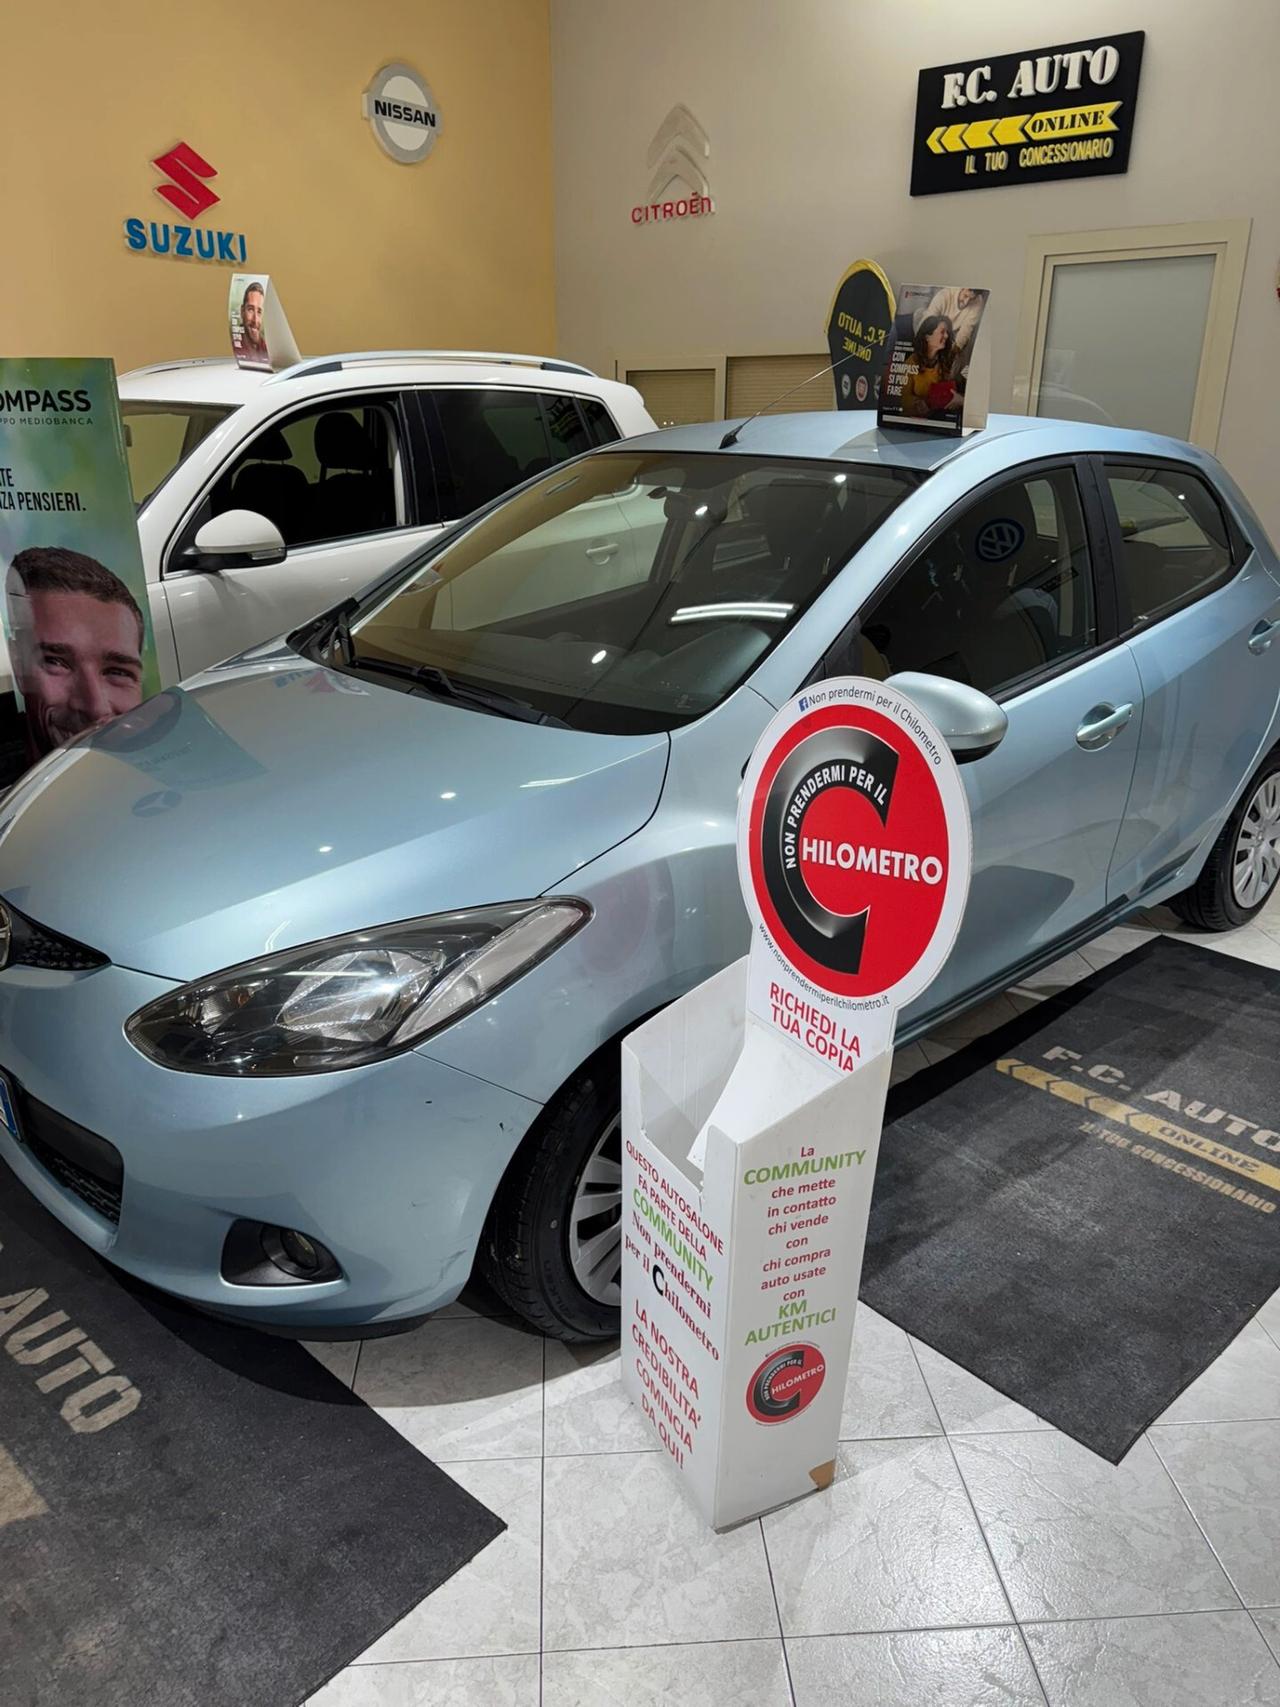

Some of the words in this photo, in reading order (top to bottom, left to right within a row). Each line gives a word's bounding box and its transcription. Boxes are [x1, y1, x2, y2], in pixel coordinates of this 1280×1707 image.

[941, 65, 997, 109] F.C.
[1007, 45, 1120, 98] AUTO
[374, 99, 436, 127] NISSAN
[1031, 110, 1105, 134] ONLINE
[964, 154, 977, 174] IL
[985, 151, 1008, 171] TUO
[1019, 137, 1114, 167] CONCESSIONARIO
[125, 217, 248, 263] SUZUKI
[890, 362, 920, 375] COMPASS
[0, 390, 91, 412] MPASS
[20, 417, 93, 425] MEDIOBANCA
[0, 468, 14, 487] TE
[0, 491, 15, 510] ZA
[17, 491, 87, 512] PENSIERI.
[808, 690, 826, 706] Non
[828, 686, 876, 701] prendermi
[876, 695, 893, 709] per
[893, 703, 901, 714] il
[900, 708, 942, 766] Chilometro
[787, 764, 845, 828] PRENDERMI
[849, 766, 873, 792] PER
[874, 783, 888, 806] IL
[784, 832, 797, 869] NON
[769, 982, 837, 1041] RICHIEDI
[841, 1027, 861, 1057] LA
[771, 1003, 801, 1040] TUA
[805, 1028, 855, 1072] COPIA
[1143, 1089, 1280, 1153] AUTO
[744, 1150, 867, 1185] COMMUNITY
[800, 1146, 815, 1158] La
[1158, 1126, 1261, 1174] ONLINE
[771, 1186, 794, 1199] che
[798, 1178, 836, 1194] mette
[1132, 1144, 1277, 1214] CONCESSIONARIO
[626, 1140, 659, 1183] QUESTO
[661, 1178, 724, 1256] AUTOSALONE
[767, 1207, 779, 1218] in
[783, 1195, 837, 1215] contatto
[638, 1174, 648, 1194] FA
[650, 1187, 676, 1226] PARTE
[678, 1220, 707, 1262] DELLA
[768, 1222, 787, 1235] chi
[790, 1214, 829, 1231] vende
[633, 1188, 714, 1292] COMMUNITY
[786, 1236, 808, 1249] con
[632, 1210, 651, 1246] Non
[654, 1242, 713, 1320] prendermi
[761, 1274, 790, 1290] auto
[793, 1266, 826, 1282] usate
[762, 1258, 781, 1272] chi
[784, 1248, 831, 1267] compra
[625, 1233, 640, 1260] per
[643, 1253, 650, 1274] il
[653, 1264, 719, 1361] Chilometro
[778, 1299, 808, 1319] KM
[783, 1289, 805, 1301] con
[744, 1308, 837, 1346] AUTENTICI
[0, 1287, 142, 1434] AUTO
[635, 1299, 647, 1329] LA
[651, 1321, 699, 1400] NOSTRA
[632, 1324, 702, 1429] CREDIBILITA'
[636, 1358, 693, 1454] COMINCIA
[642, 1392, 656, 1427] DA
[659, 1422, 684, 1470] QUI!
